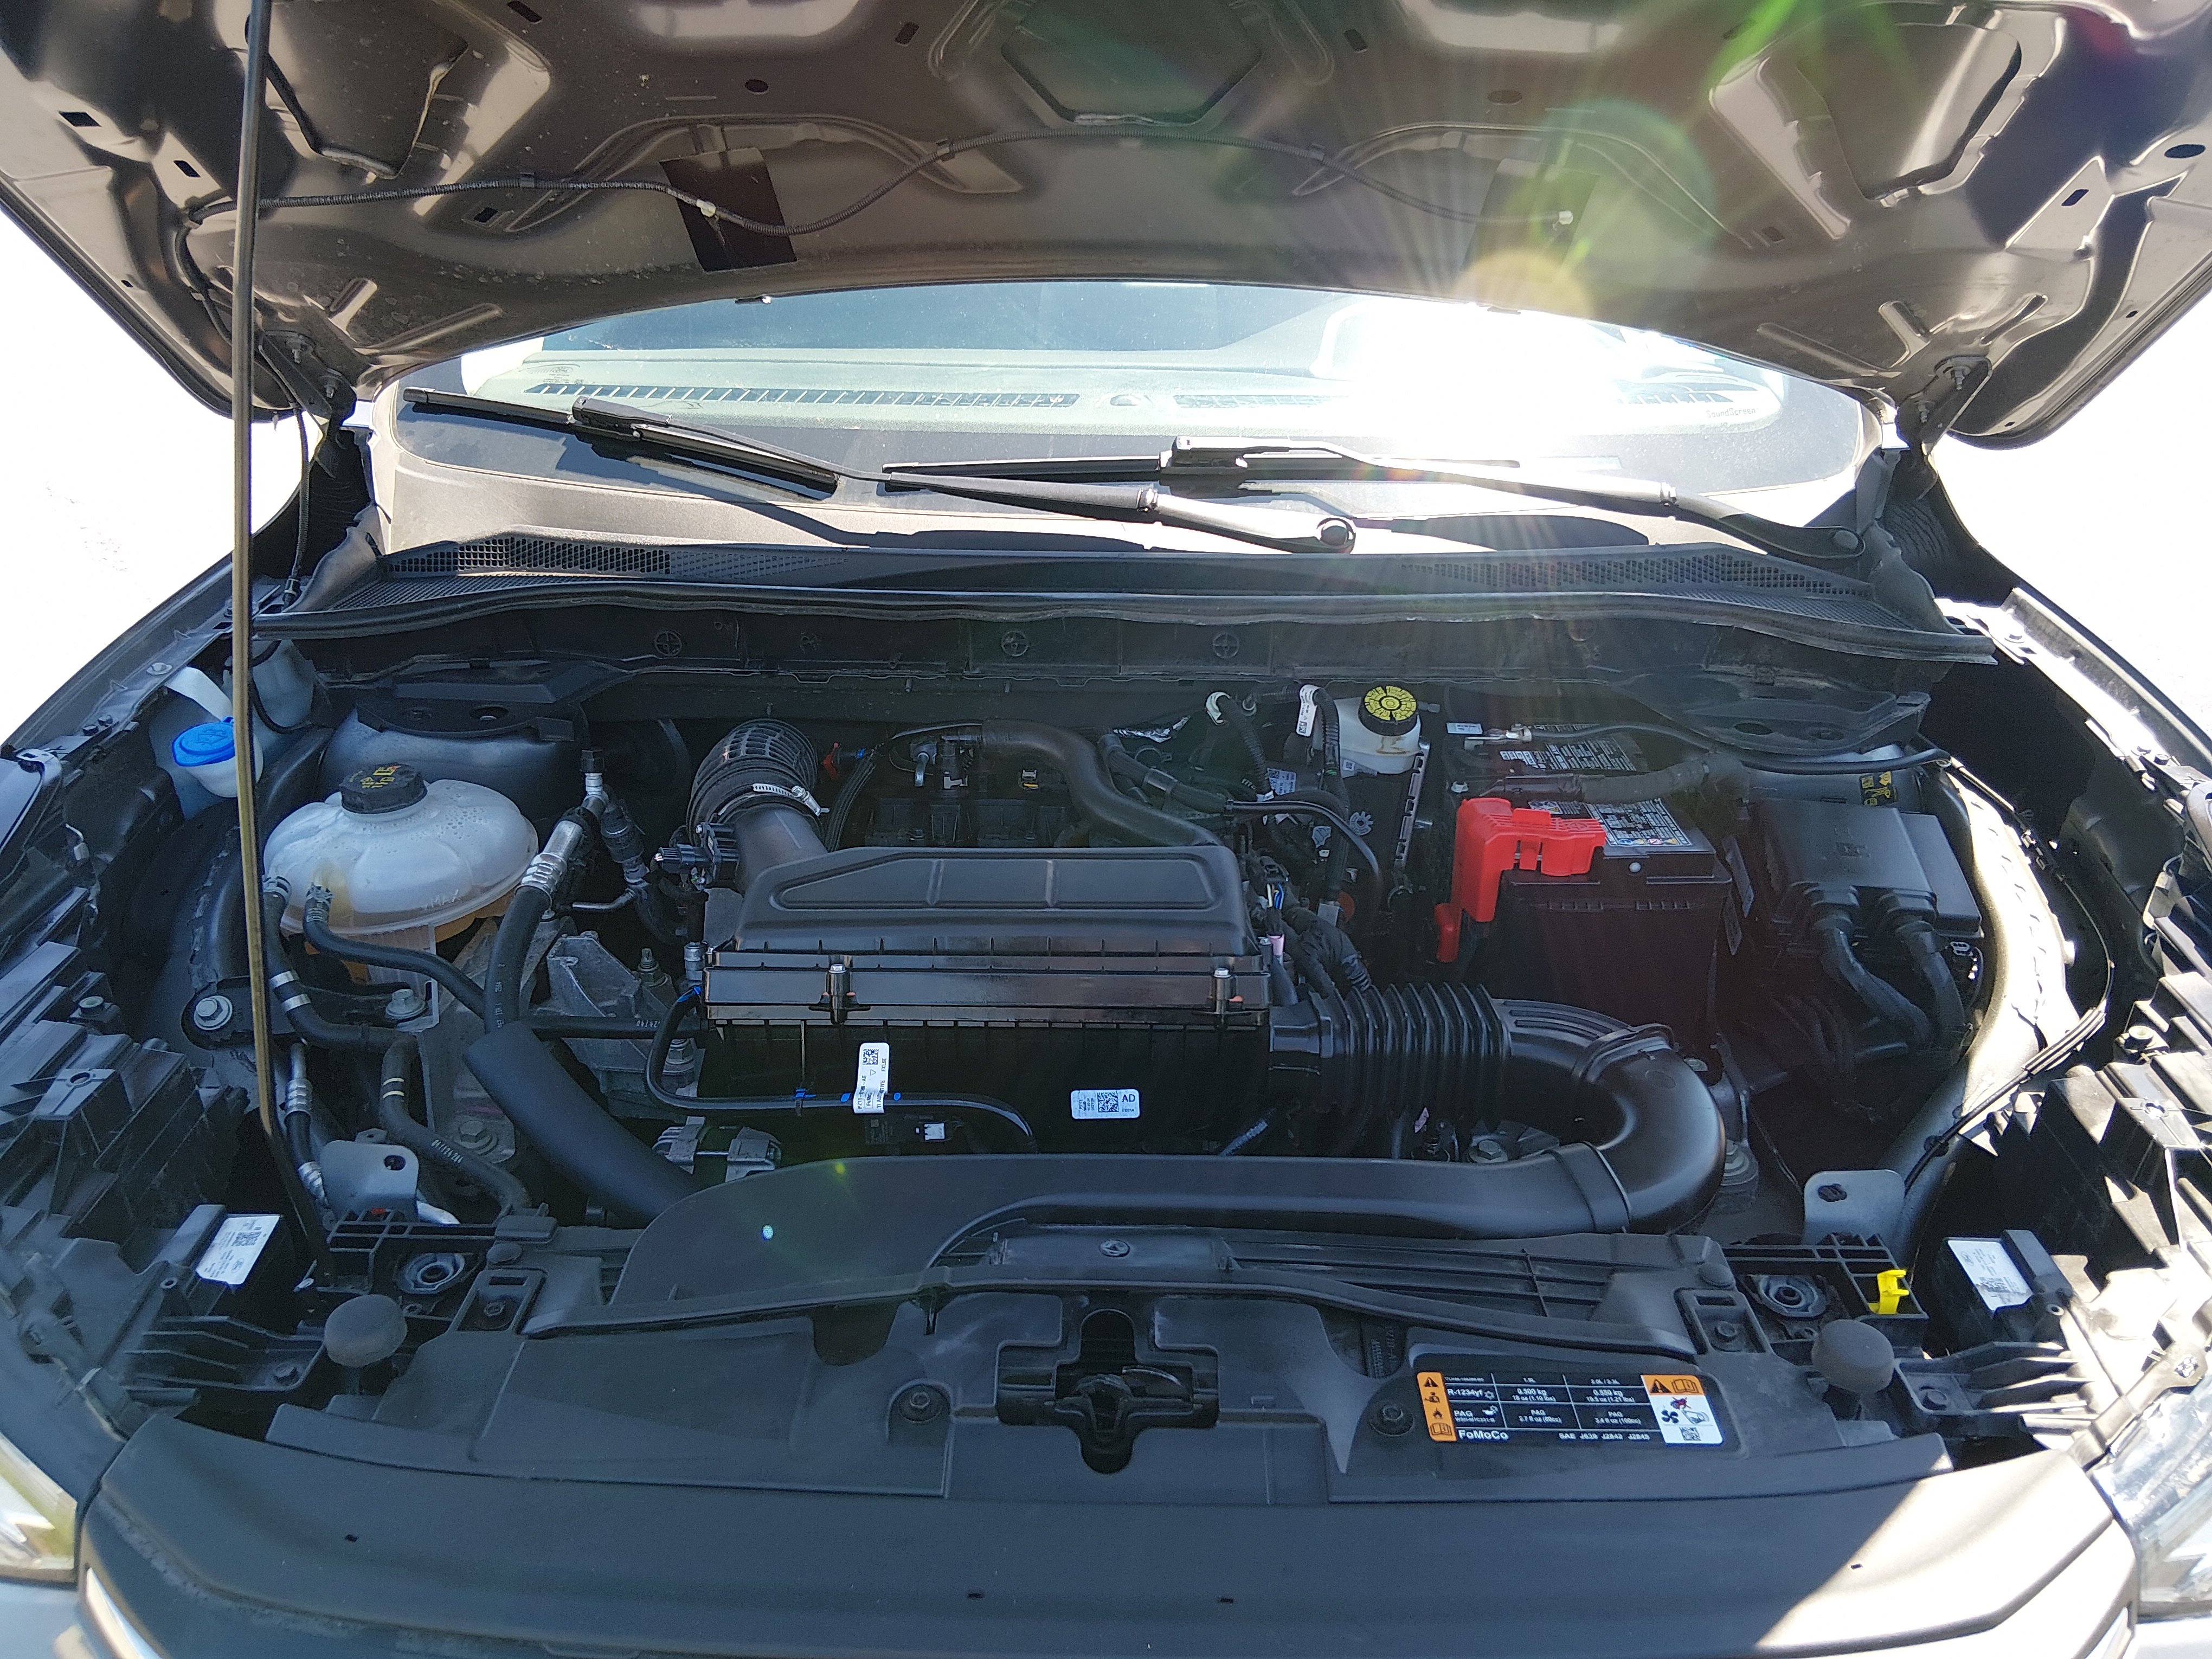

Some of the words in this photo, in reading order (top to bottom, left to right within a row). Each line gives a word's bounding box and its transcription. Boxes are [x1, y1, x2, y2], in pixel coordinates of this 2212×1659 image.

[1706, 408, 1756, 418] SoundScreen
[1122, 1094, 1136, 1102] AD
[1447, 1388, 1483, 1398] R-1234yf
[1458, 1430, 1509, 1441] FoMoCo
